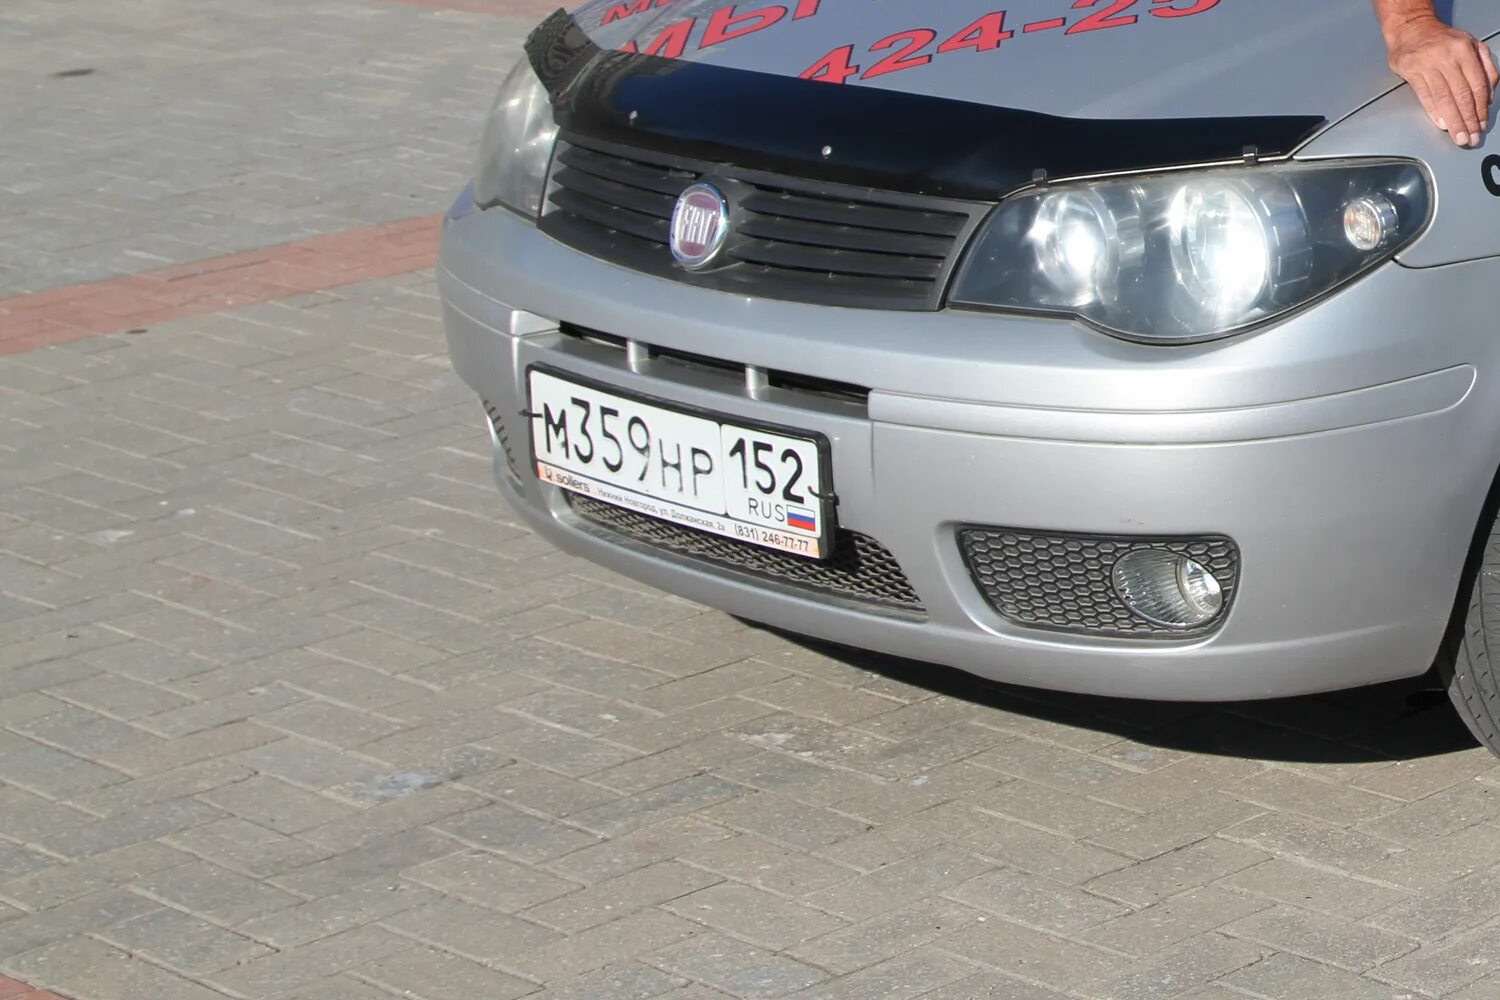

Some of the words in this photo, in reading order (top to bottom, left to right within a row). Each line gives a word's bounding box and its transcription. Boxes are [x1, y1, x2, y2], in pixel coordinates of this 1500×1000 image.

[555, 474, 591, 493] sollers
[729, 437, 805, 505] 152
[748, 497, 786, 523] RUS
[734, 523, 759, 542] (831)
[761, 531, 810, 552] 246-77-77
